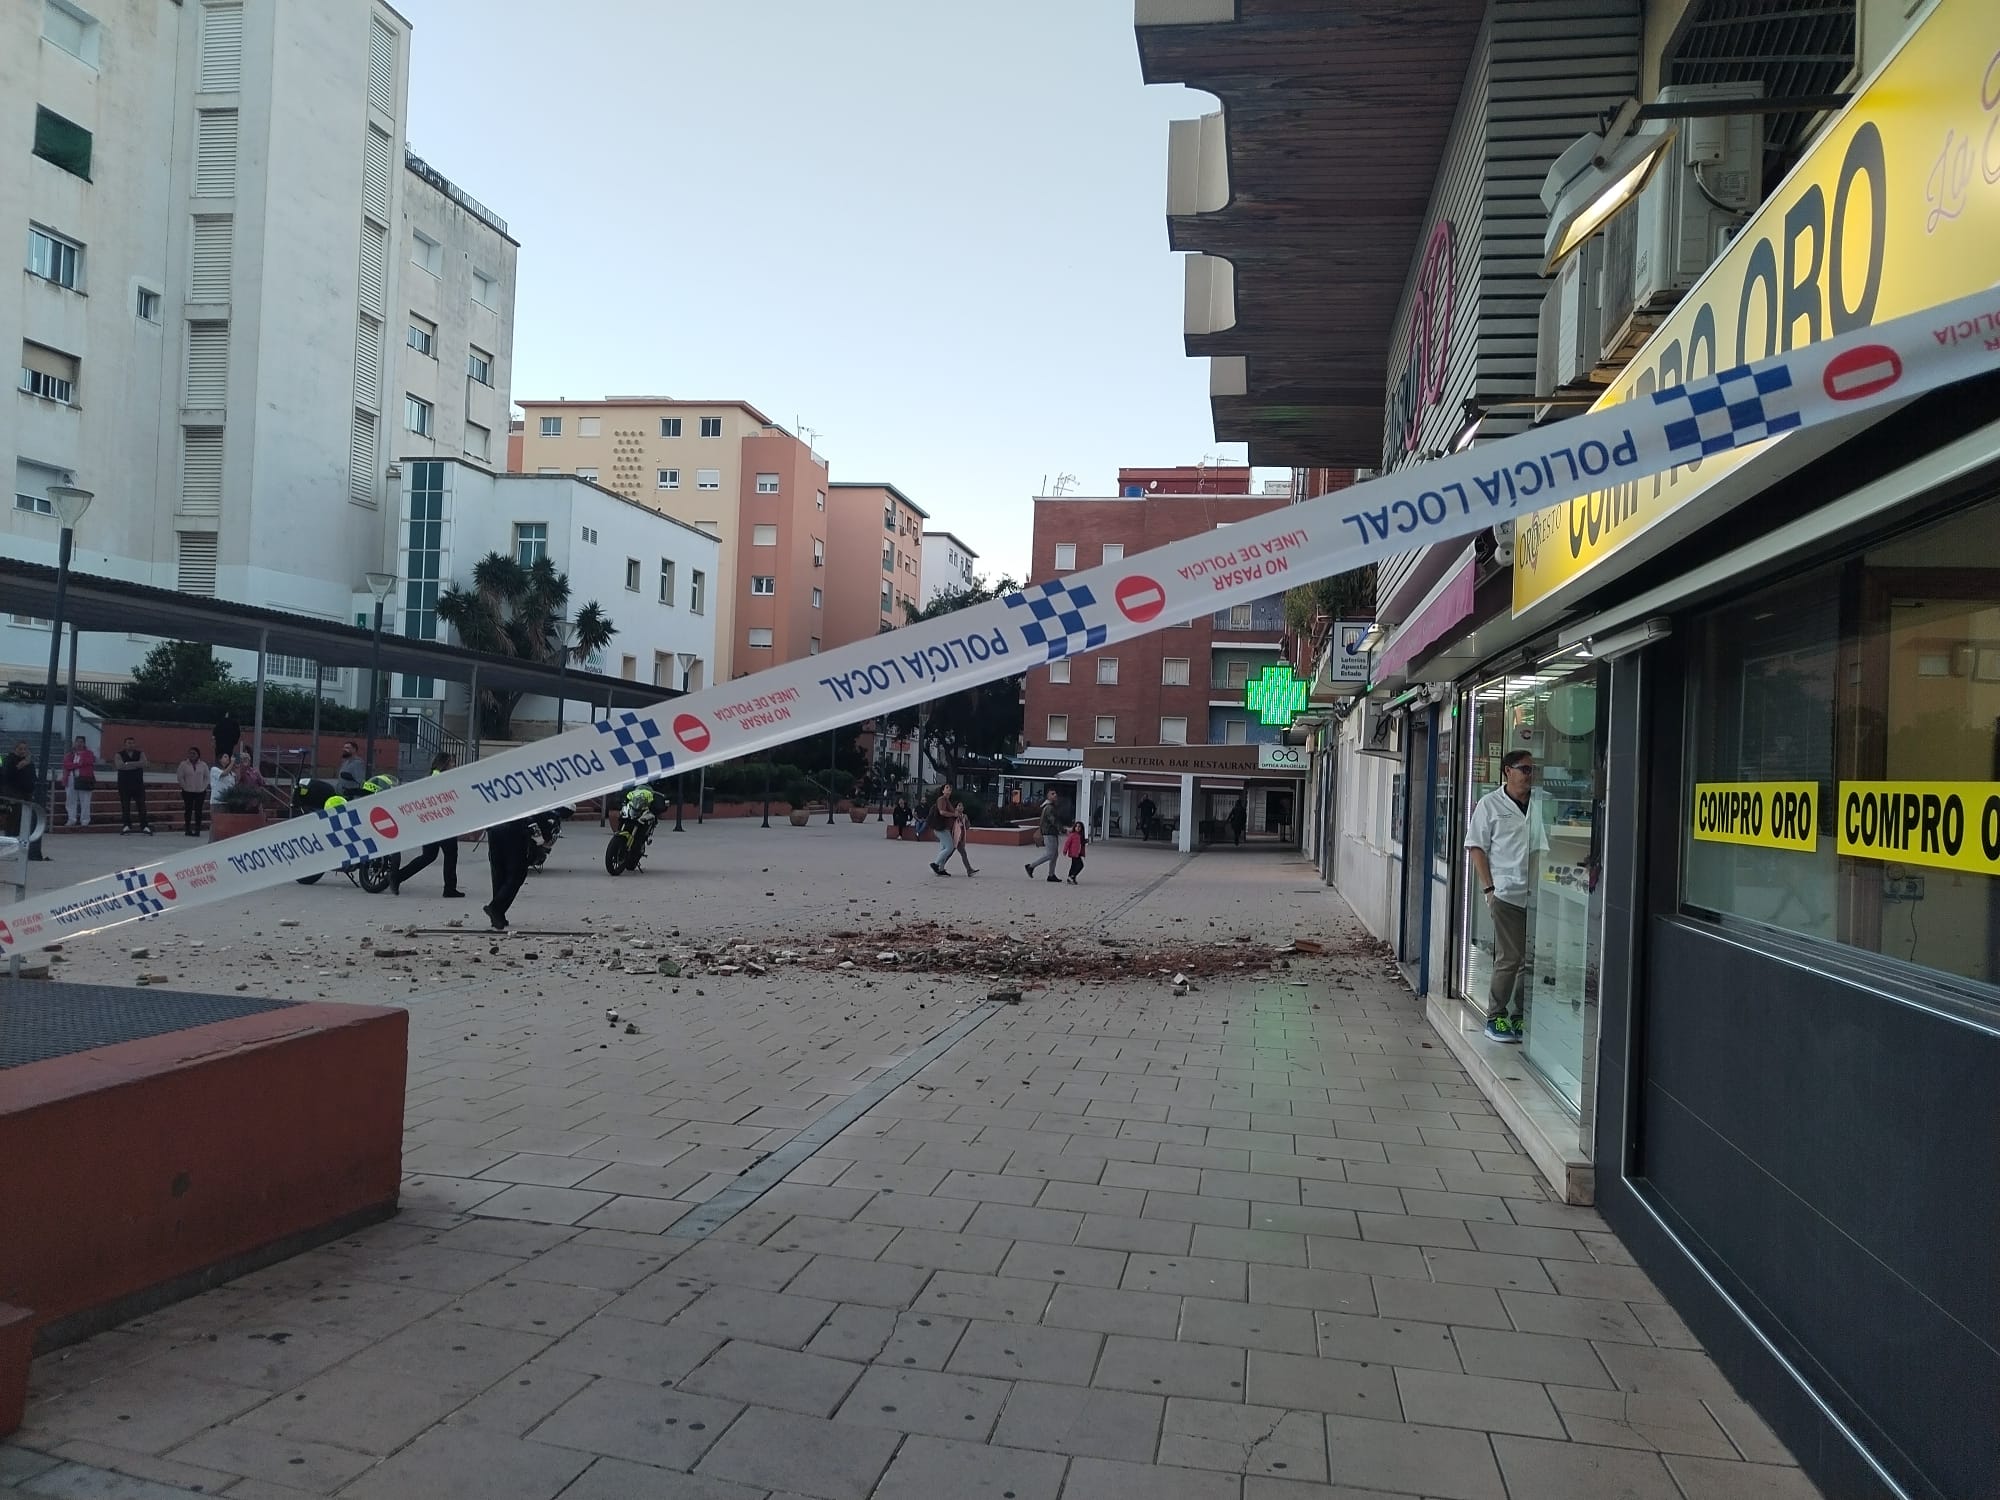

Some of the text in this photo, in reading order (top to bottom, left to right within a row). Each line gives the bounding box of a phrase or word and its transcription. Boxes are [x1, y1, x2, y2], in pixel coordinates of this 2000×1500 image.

[1342, 429, 1639, 545] POLICÍA LOCAL
[1177, 529, 1310, 581] LÍNEA DE POLICÍA
[1212, 556, 1288, 591] NO PASAR
[819, 627, 1010, 702] POLICÍA LOCAL
[713, 701, 754, 722] POLICÍA
[740, 706, 792, 730] NO PASAR
[752, 696, 770, 710] DE
[471, 749, 605, 803] POLICÍA LOCAL
[1112, 756, 1165, 767] CAFETERIA
[1169, 757, 1189, 768] BAR
[1699, 791, 1812, 841] COMPRO ORO
[1846, 791, 1965, 857] COMPRO
[227, 832, 325, 874] POLICÍA LOCAL
